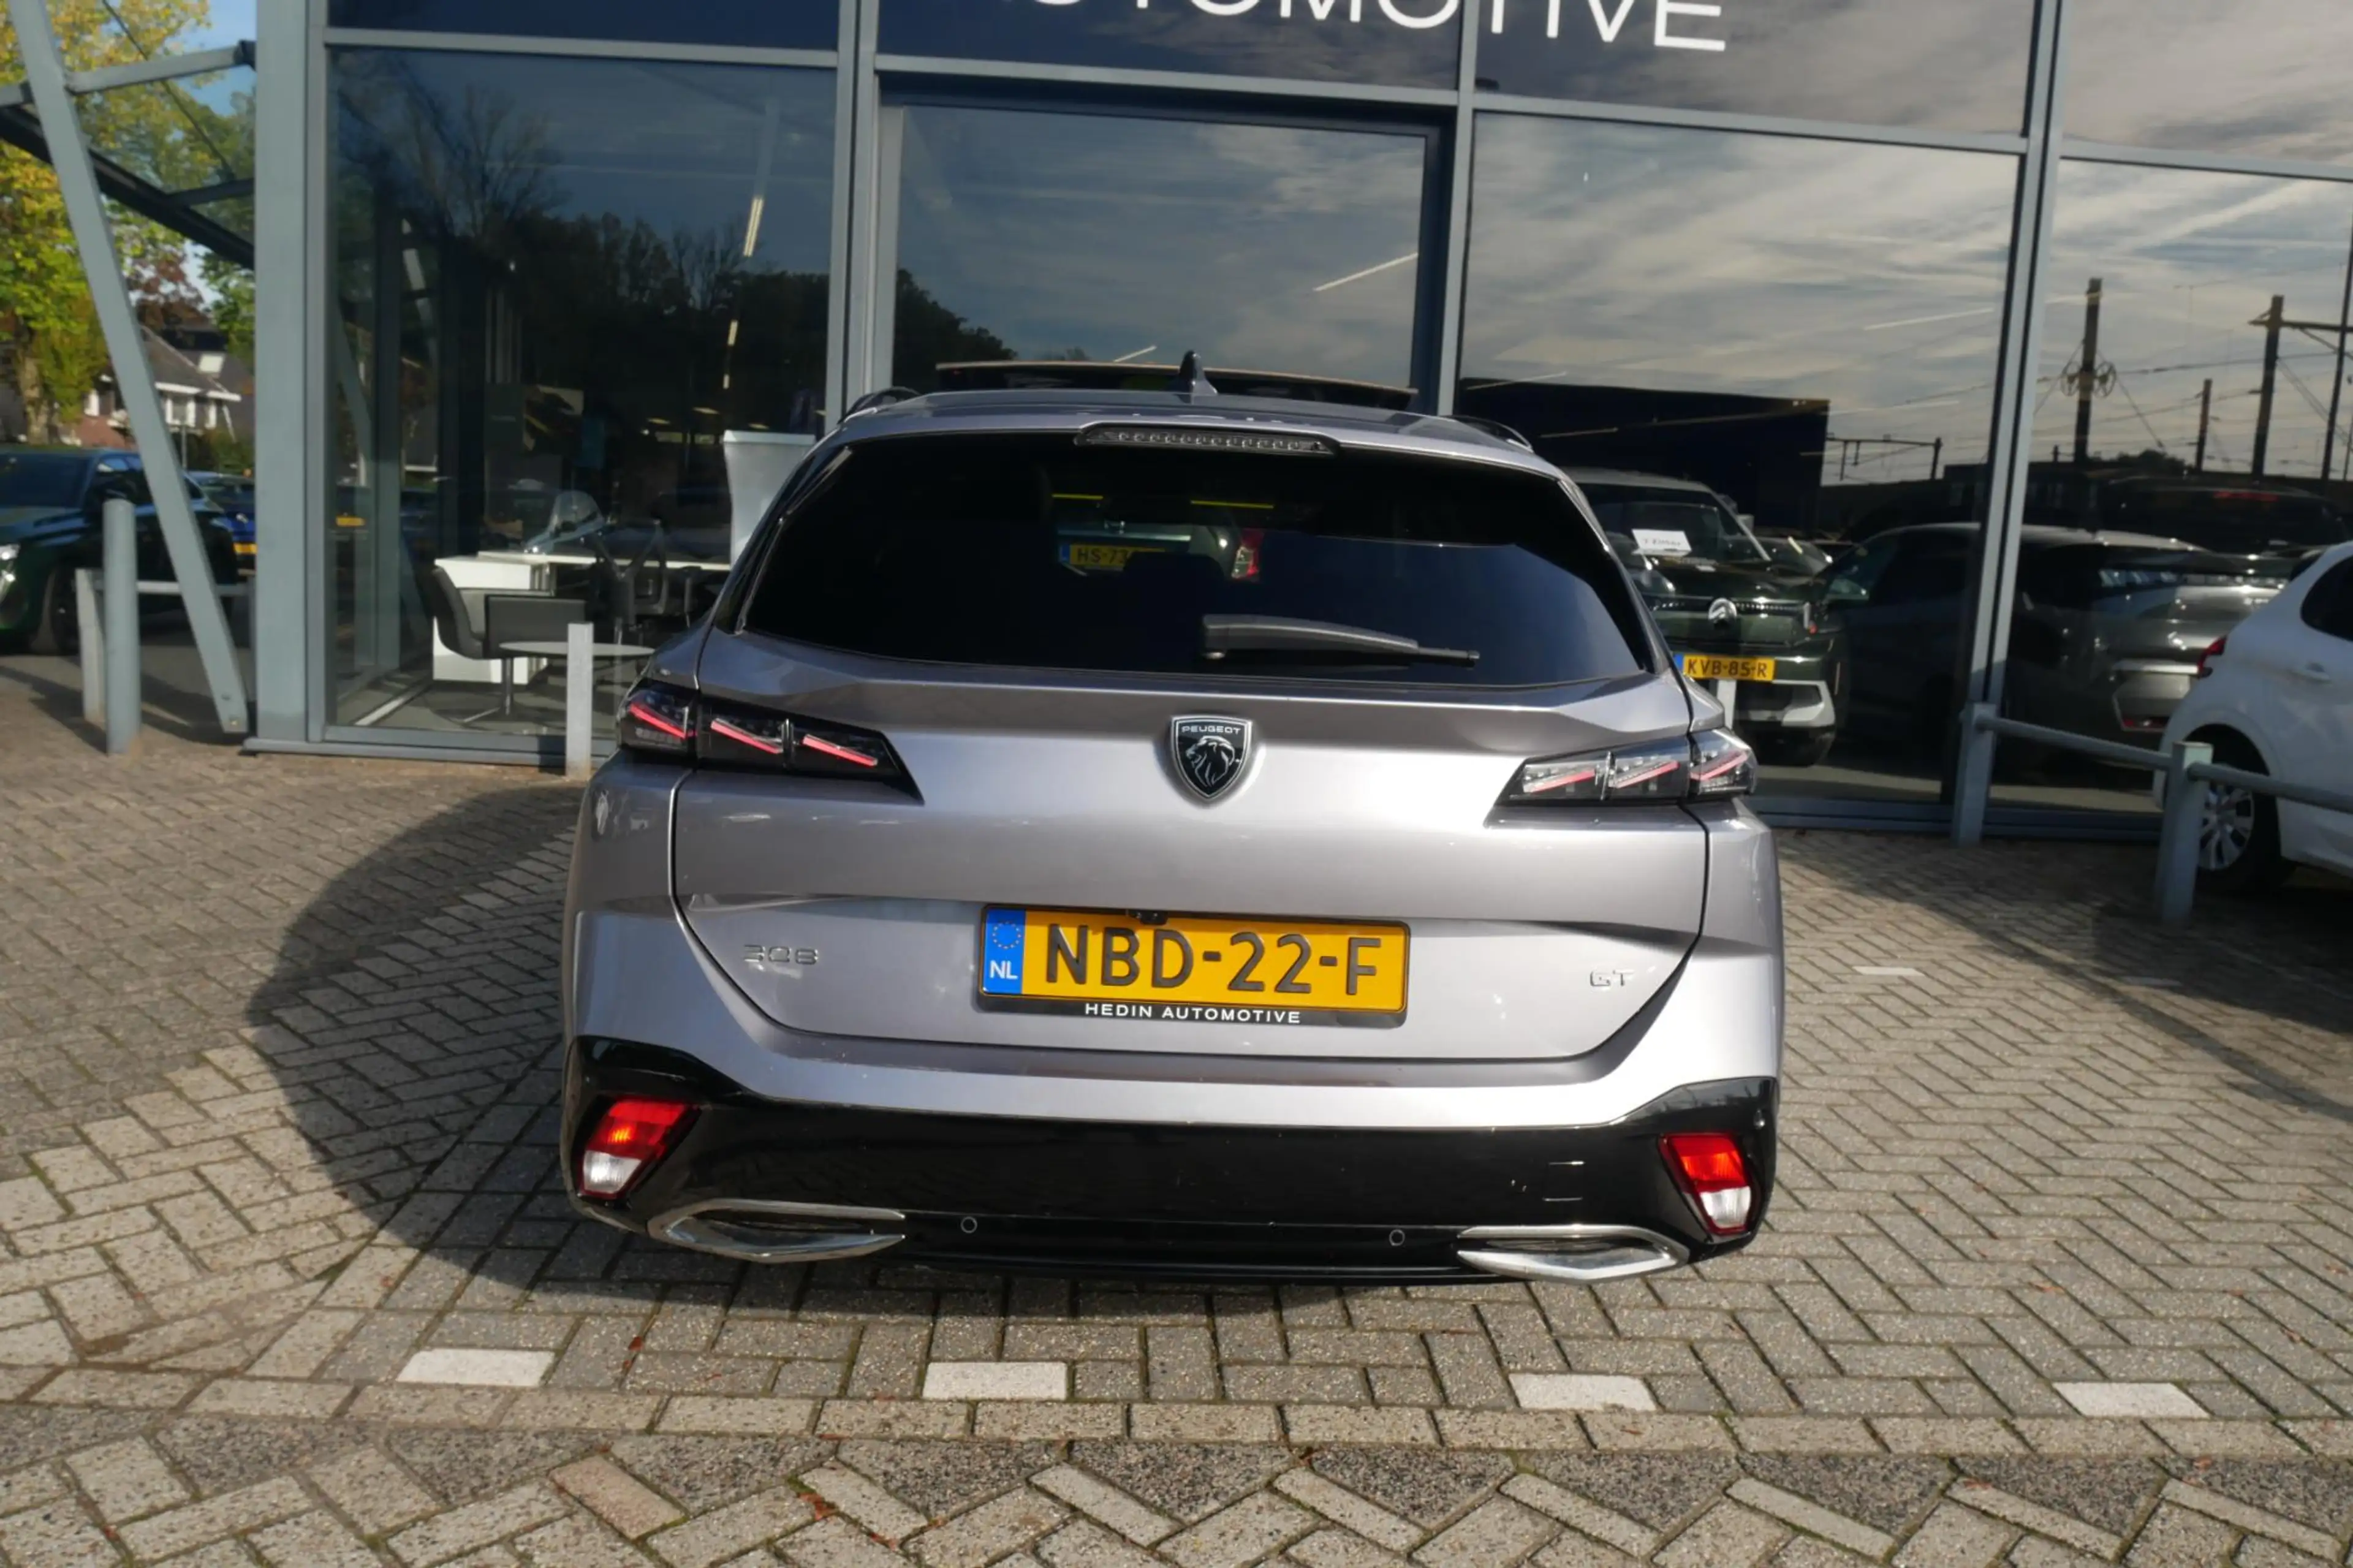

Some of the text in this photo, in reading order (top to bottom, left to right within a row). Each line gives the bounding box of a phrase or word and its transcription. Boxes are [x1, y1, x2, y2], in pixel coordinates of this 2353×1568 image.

[1077, 547, 1130, 564] HS-73
[1687, 659, 1768, 677] KVB-85-R
[1181, 725, 1241, 735] PEUGEOT
[743, 944, 818, 965] 308
[1045, 923, 1381, 996] NBD-22-F
[989, 960, 1018, 980] NL
[1590, 969, 1635, 987] GT
[1085, 1002, 1301, 1024] HEDIN AUTOMOTIVE
